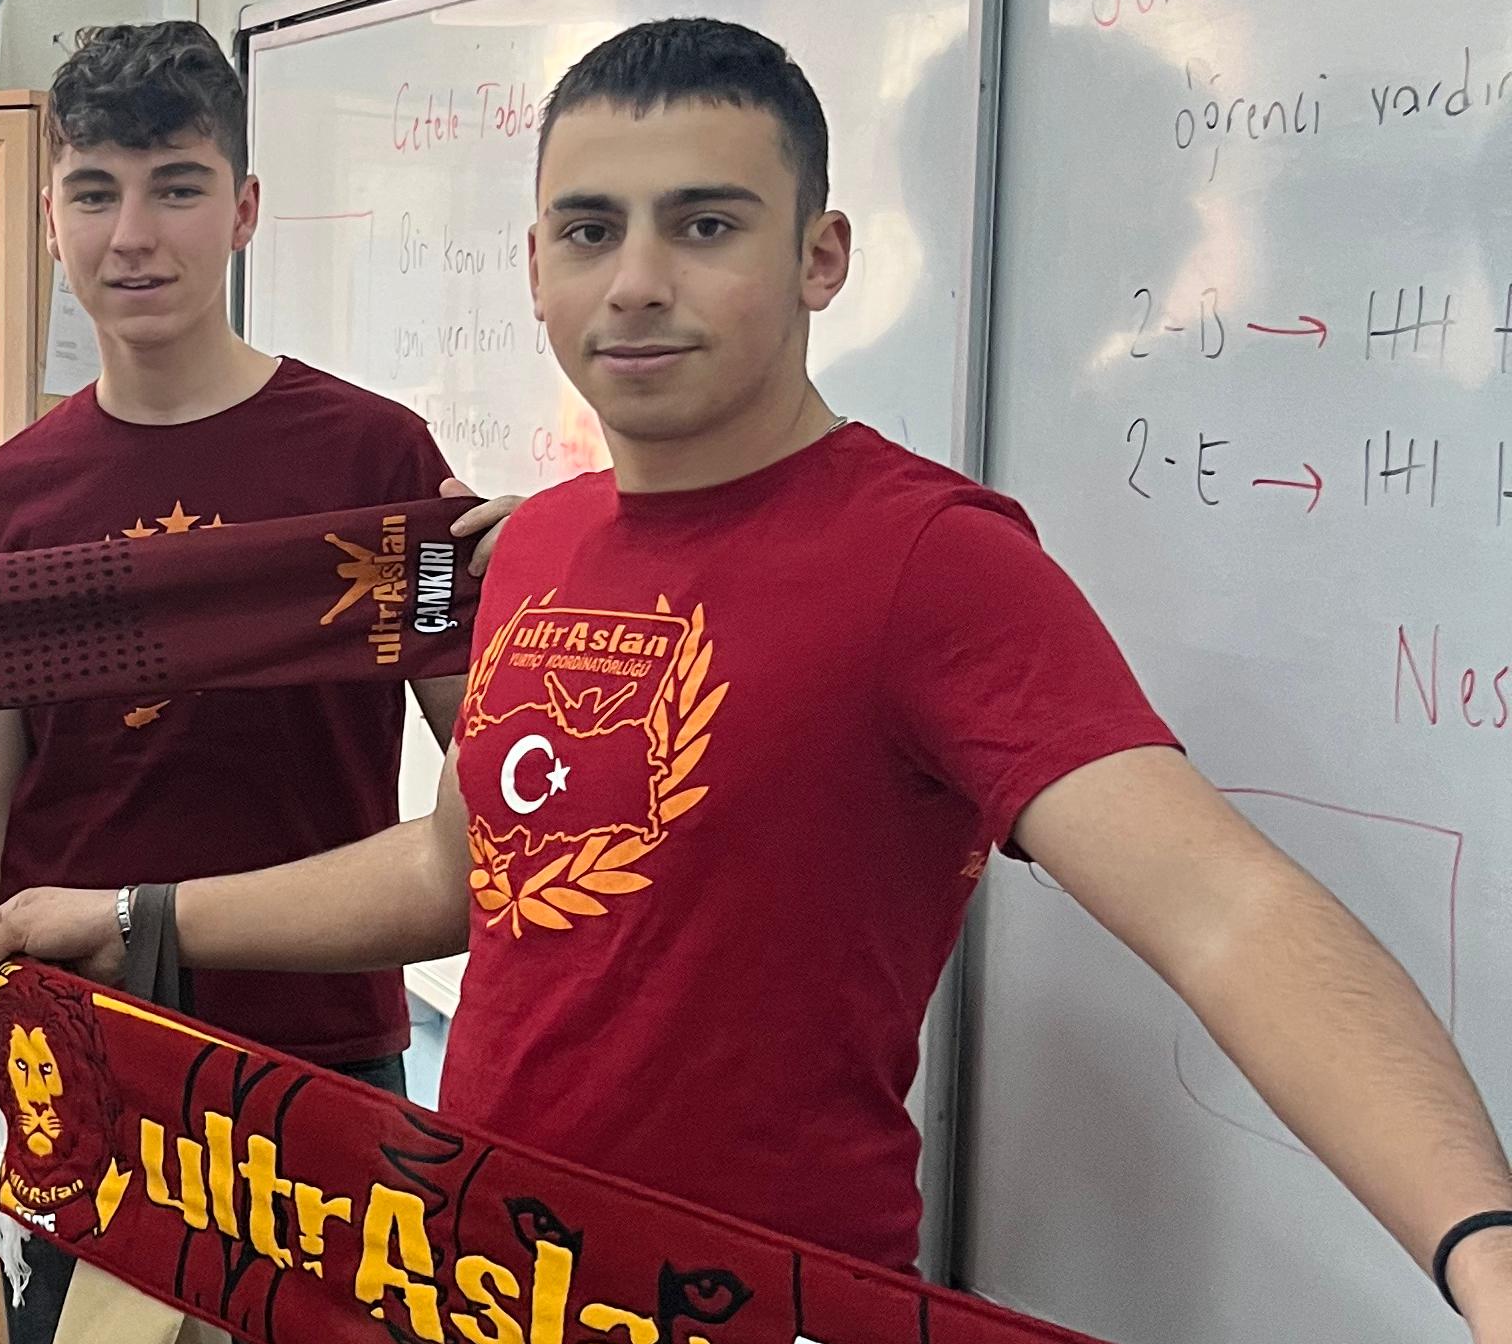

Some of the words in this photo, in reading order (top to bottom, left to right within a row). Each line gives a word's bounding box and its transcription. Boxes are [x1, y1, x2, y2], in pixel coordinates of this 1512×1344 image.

[399, 212, 428, 274] Bir
[497, 220, 518, 271] ile
[1127, 417, 1231, 506] 2-E
[414, 542, 458, 634] ÇANKIRI
[513, 620, 669, 657] ultrAslan
